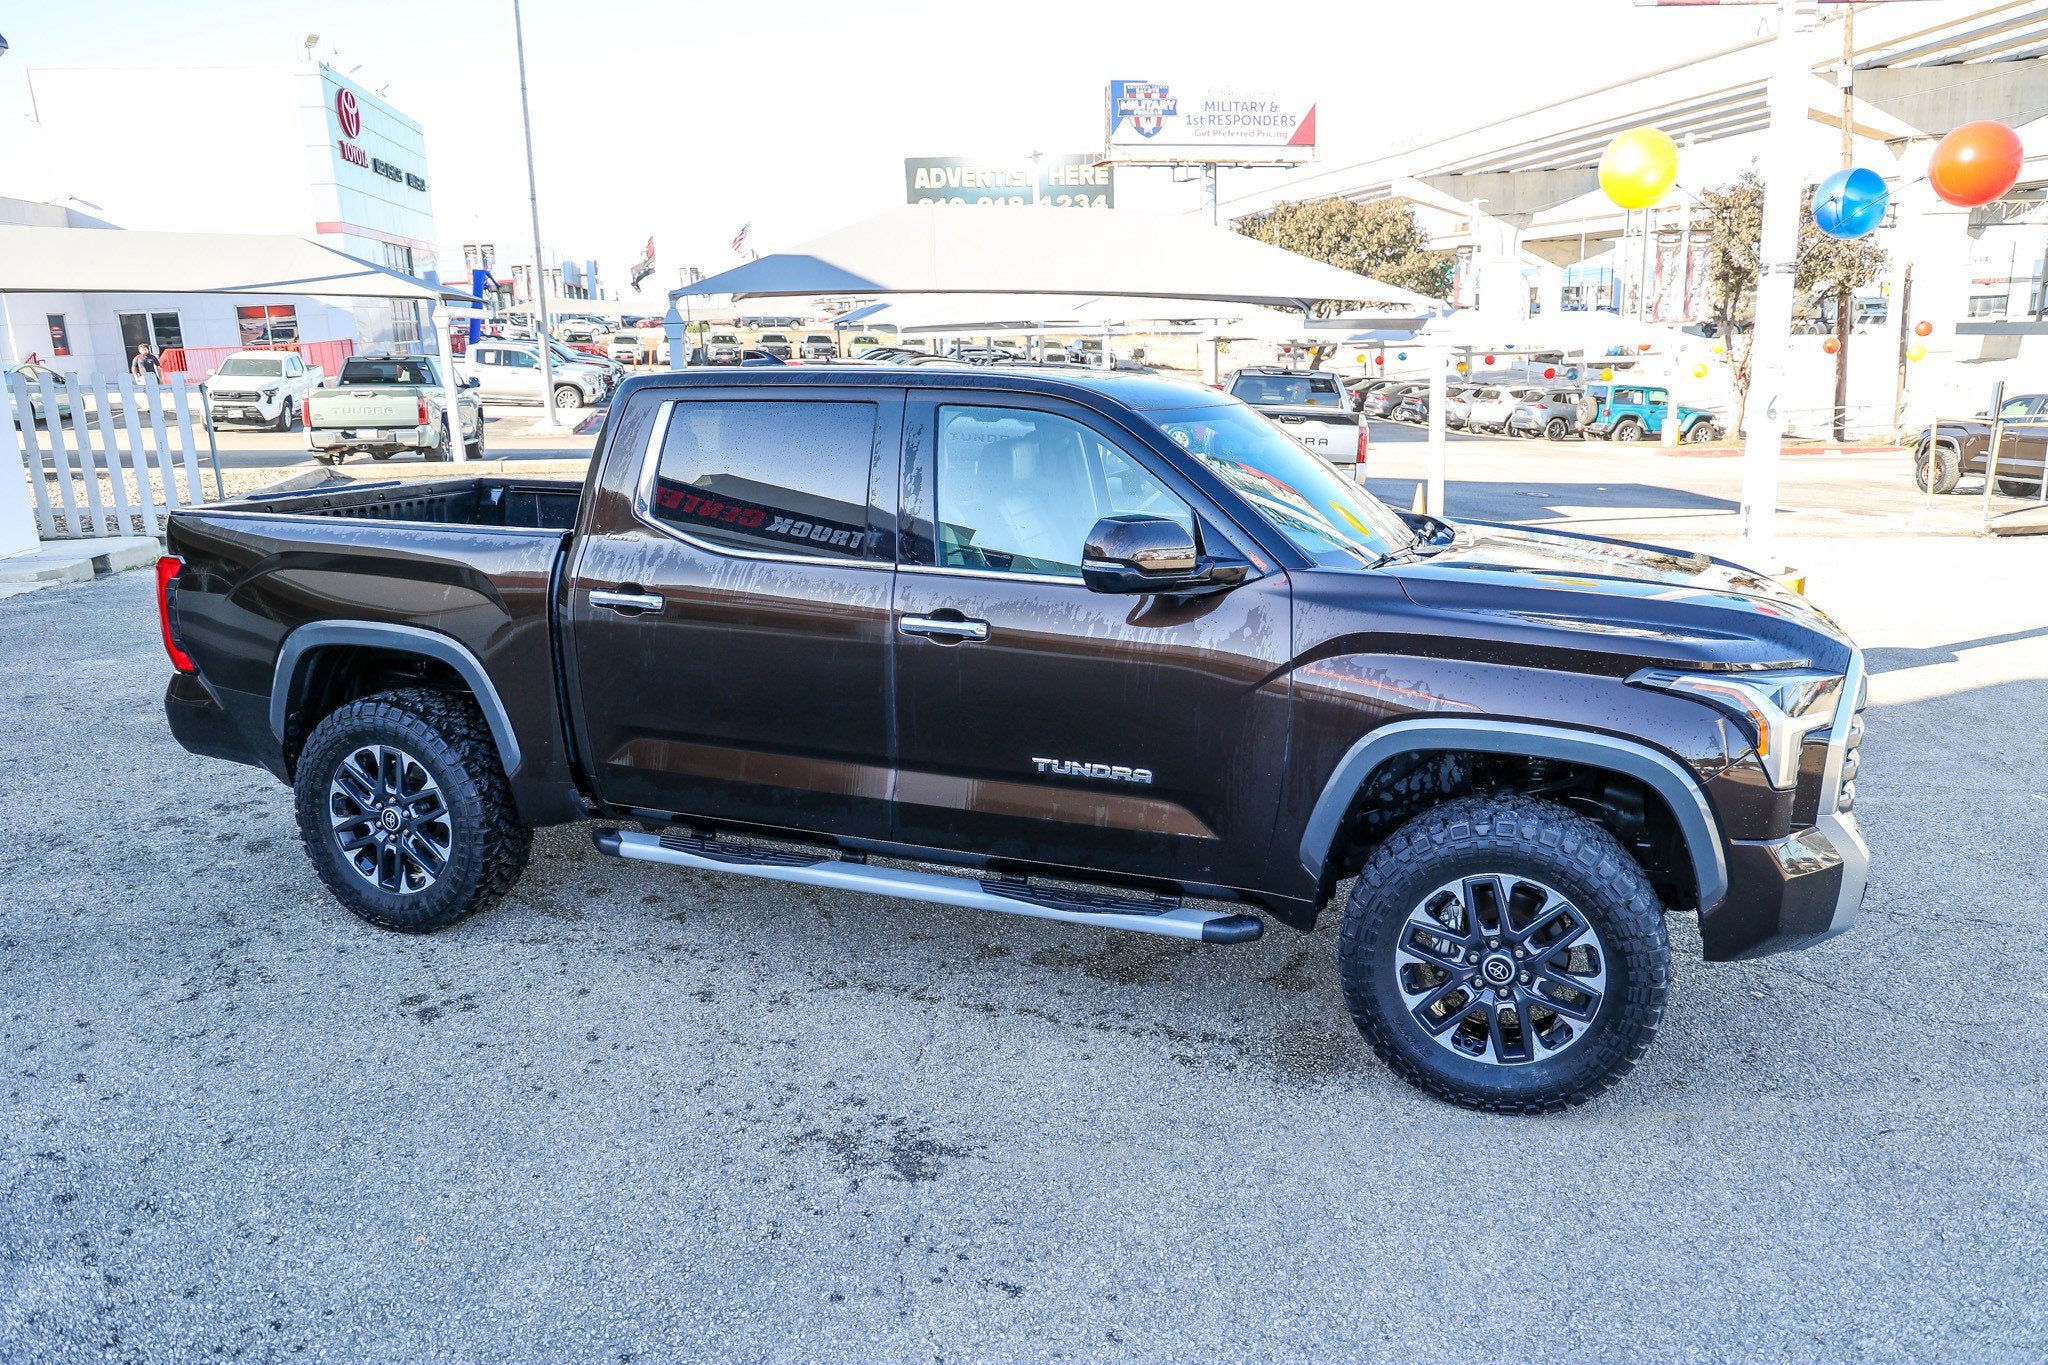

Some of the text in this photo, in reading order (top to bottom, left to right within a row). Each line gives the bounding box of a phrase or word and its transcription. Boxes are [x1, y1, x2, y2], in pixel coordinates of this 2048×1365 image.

[1204, 101, 1278, 112] MILITARY &
[1186, 115, 1296, 126] 1st RESPONDERS
[1194, 129, 1288, 139] Get Preferred Pricing
[338, 140, 369, 169] TOYOTA
[914, 164, 1109, 189] ADVERTIS HERE
[331, 407, 395, 416] TUNDRA
[1767, 395, 1777, 420] 6
[1031, 757, 1153, 784] TUNDRA
